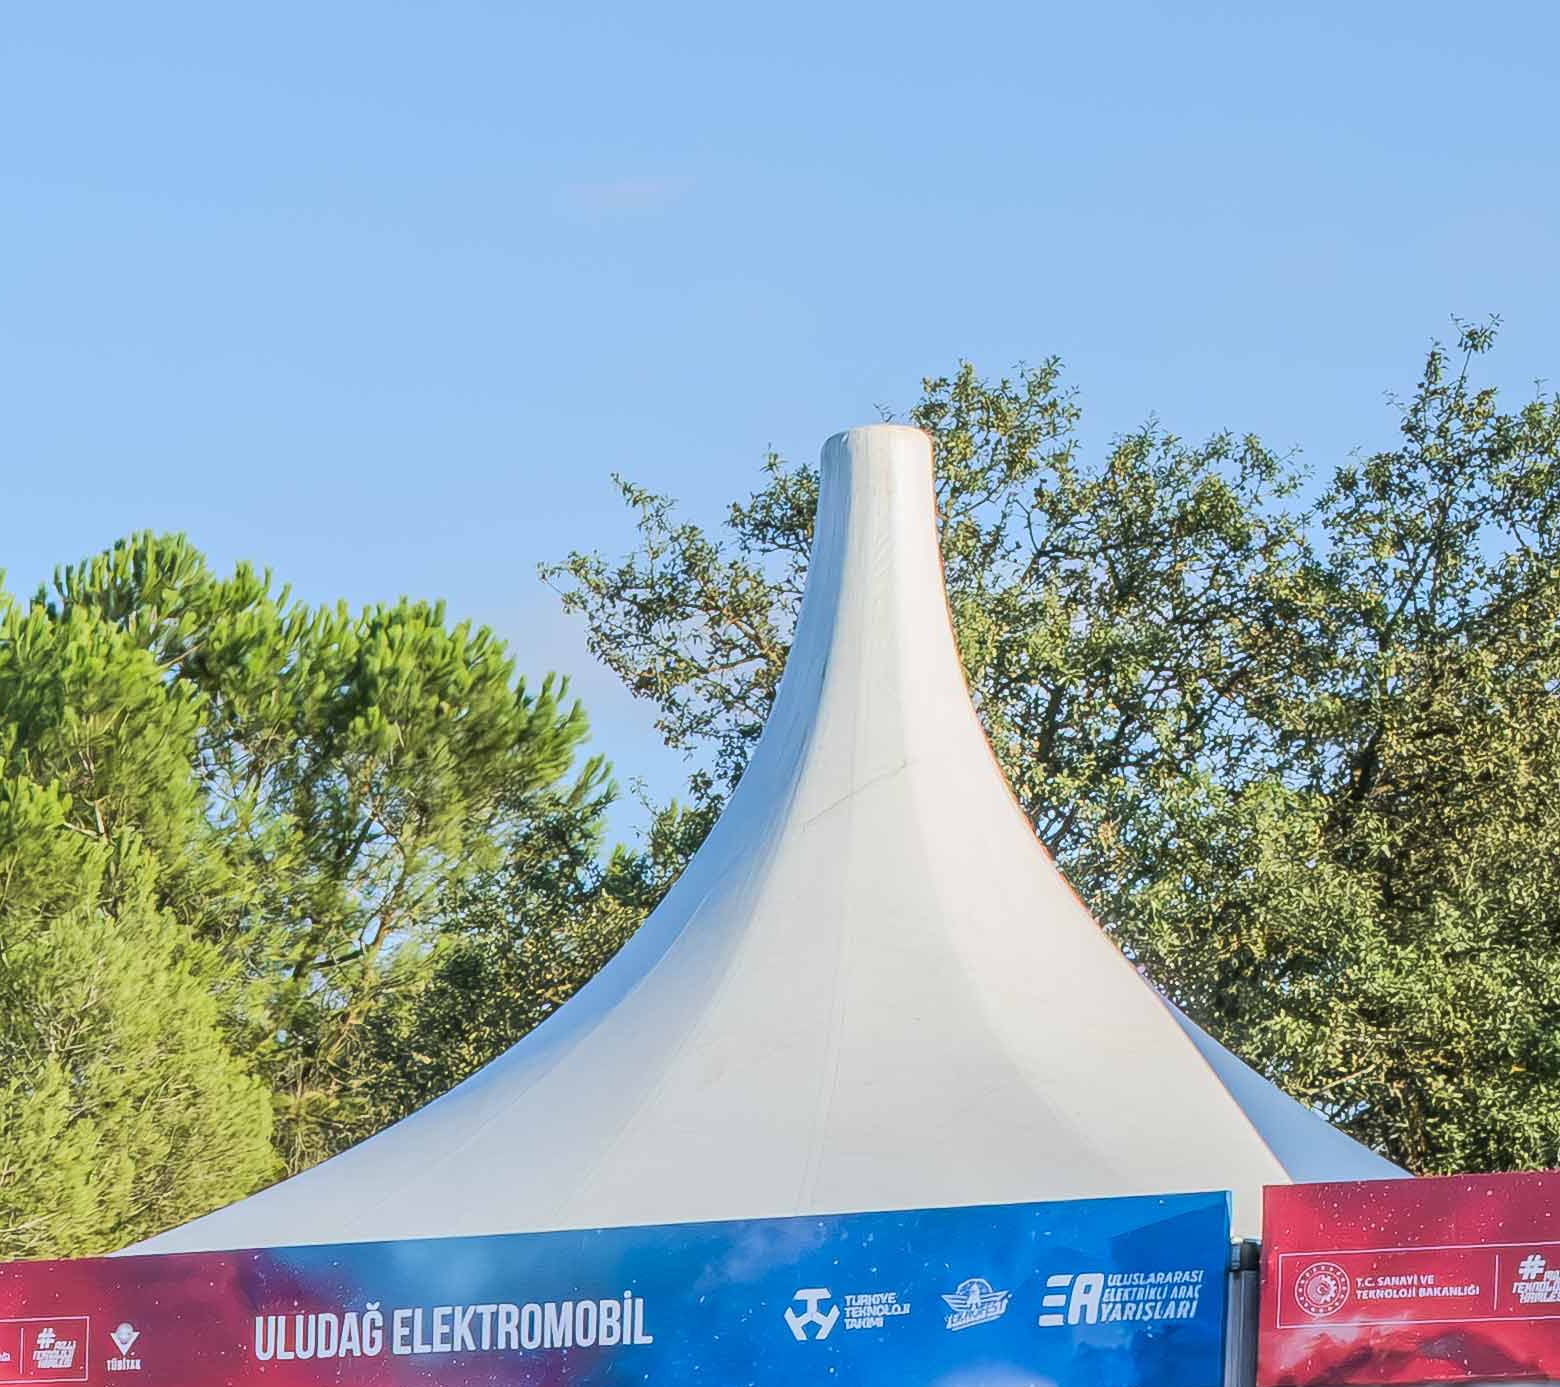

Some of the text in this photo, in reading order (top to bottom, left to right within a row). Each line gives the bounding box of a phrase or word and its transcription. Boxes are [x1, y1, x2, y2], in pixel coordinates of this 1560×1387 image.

[1107, 1270, 1204, 1287] ULUSLARARASI
[1356, 1274, 1434, 1289] T.C. SANAYİ VE
[1356, 1285, 1480, 1300] TEKNOLOJİ BAKANLIĞI
[1100, 1297, 1197, 1325] YARIŞLARI
[254, 1288, 654, 1360] ULUDAĞ ELEKTROMOBİL
